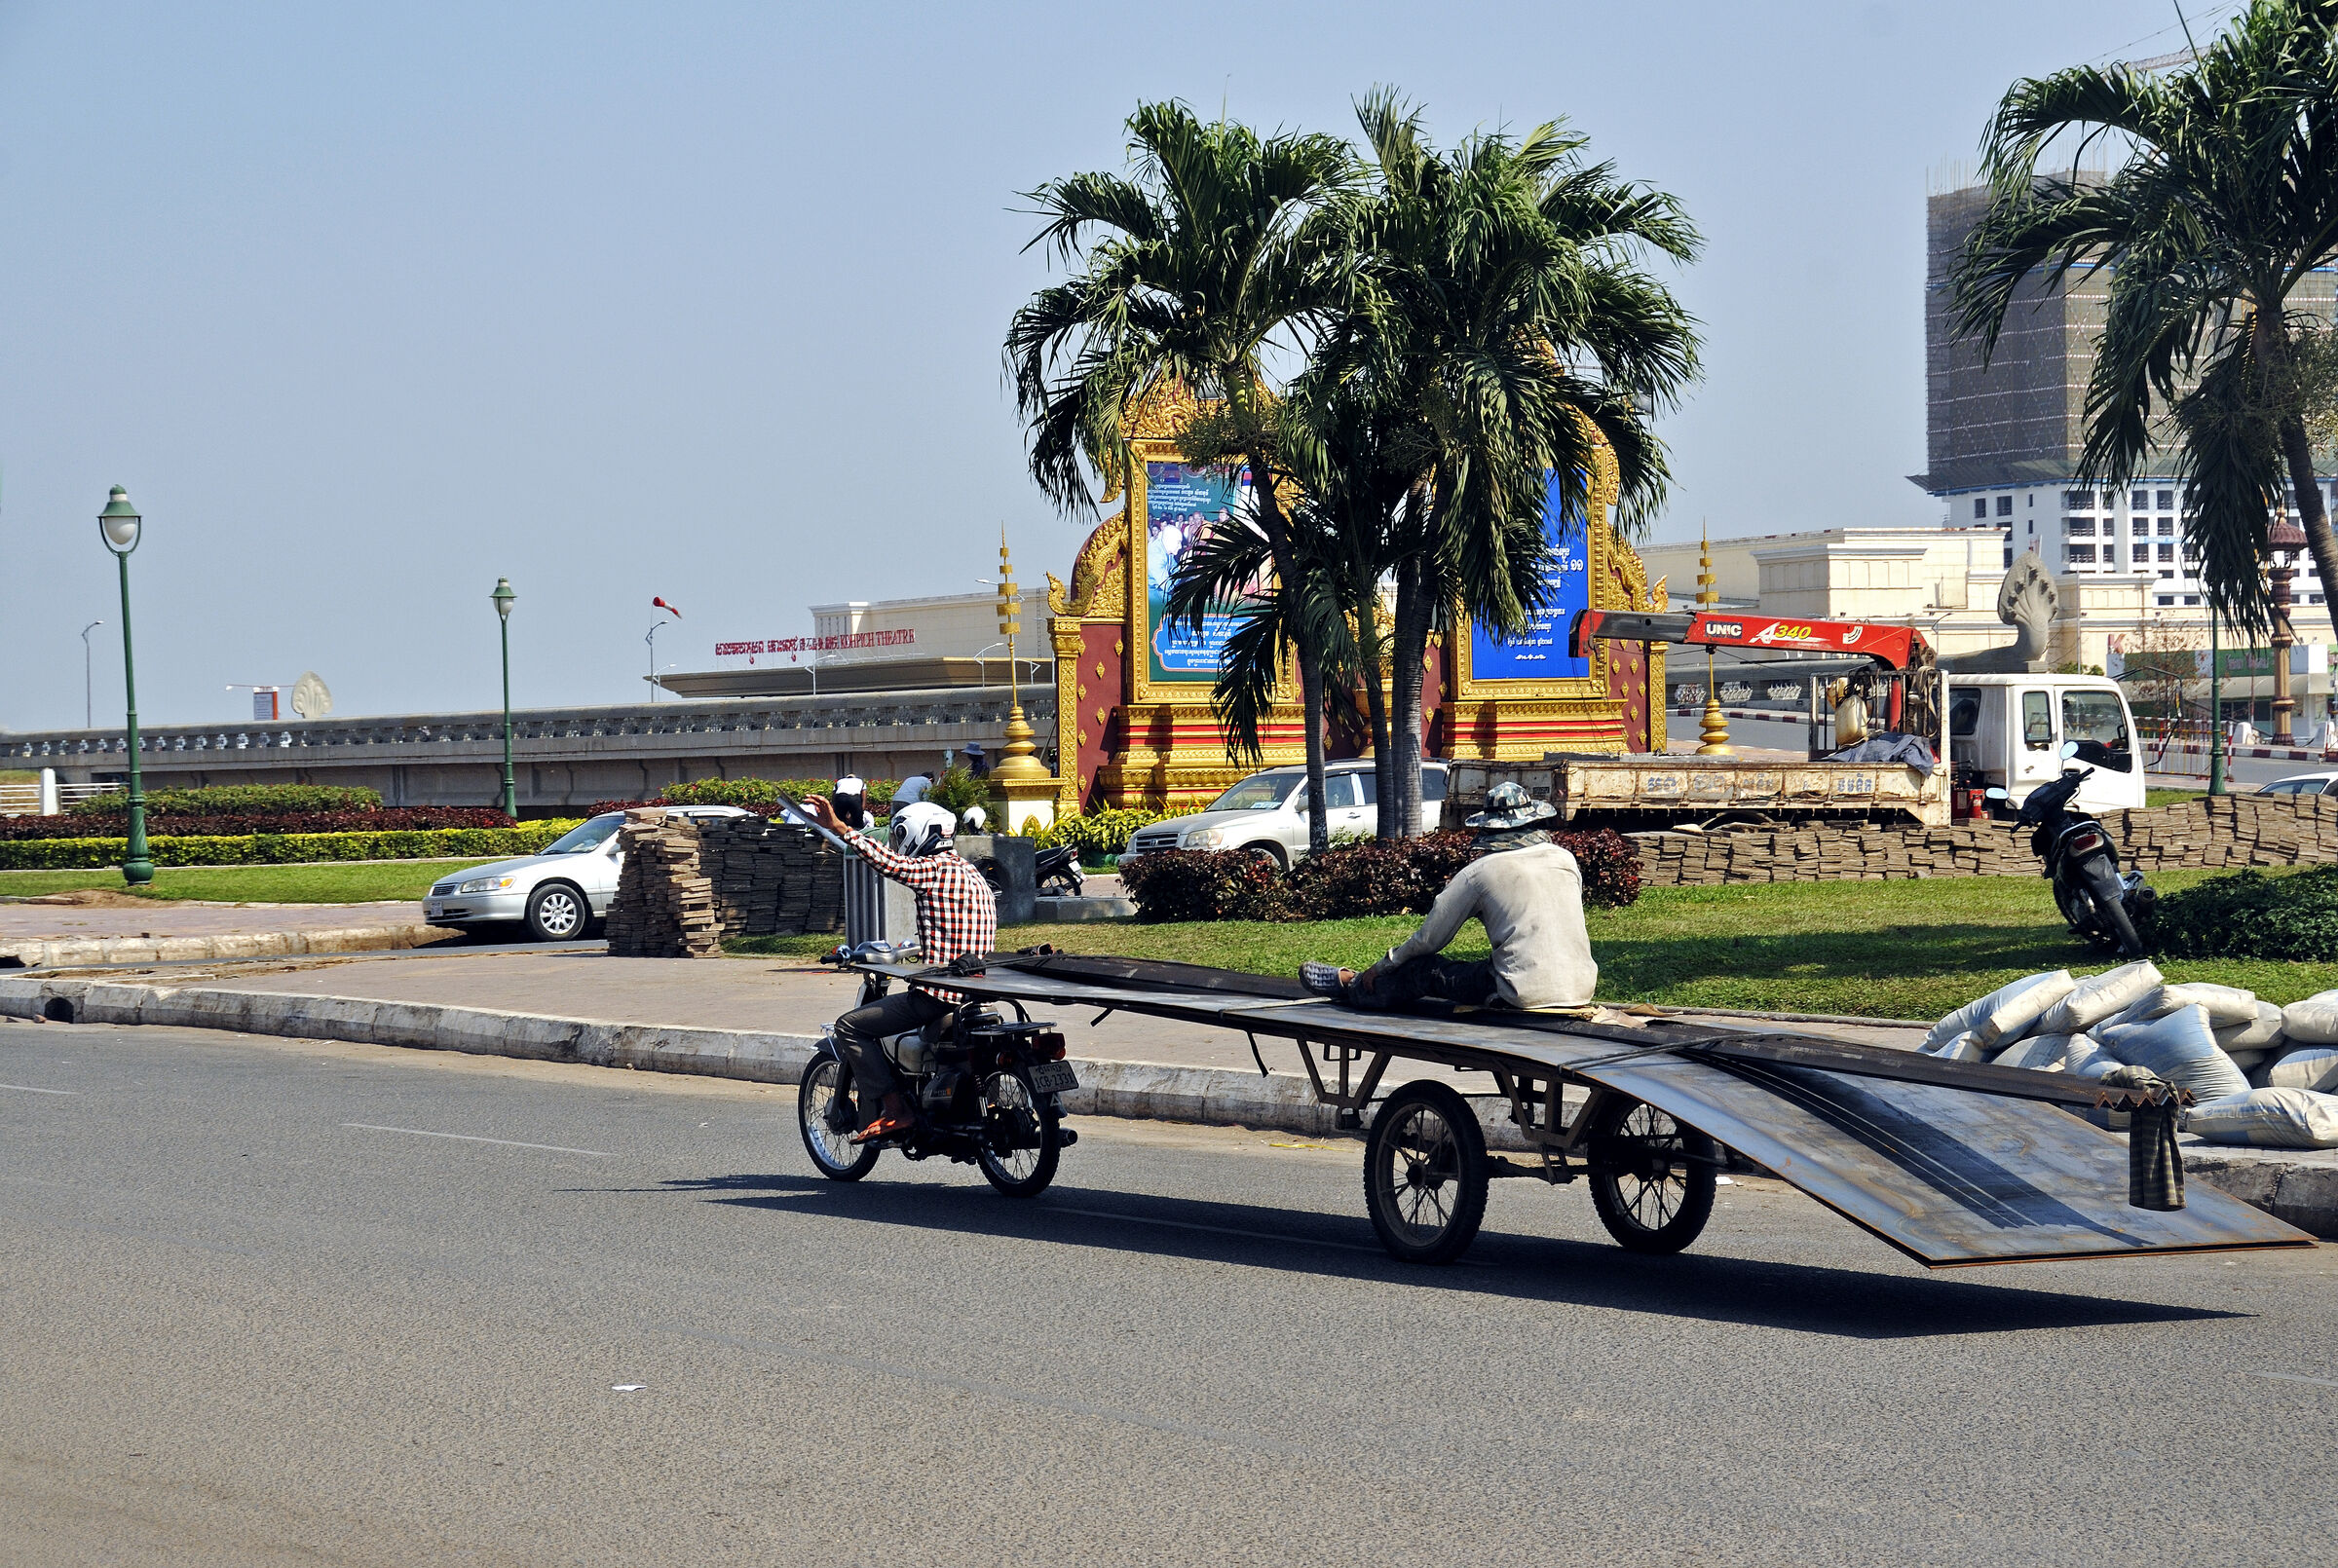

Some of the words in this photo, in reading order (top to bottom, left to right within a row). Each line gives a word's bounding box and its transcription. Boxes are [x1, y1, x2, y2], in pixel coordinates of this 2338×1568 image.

[840, 631, 875, 650] KOHPICH
[876, 628, 916, 647] THEATRE
[1706, 623, 1743, 637] UNIC
